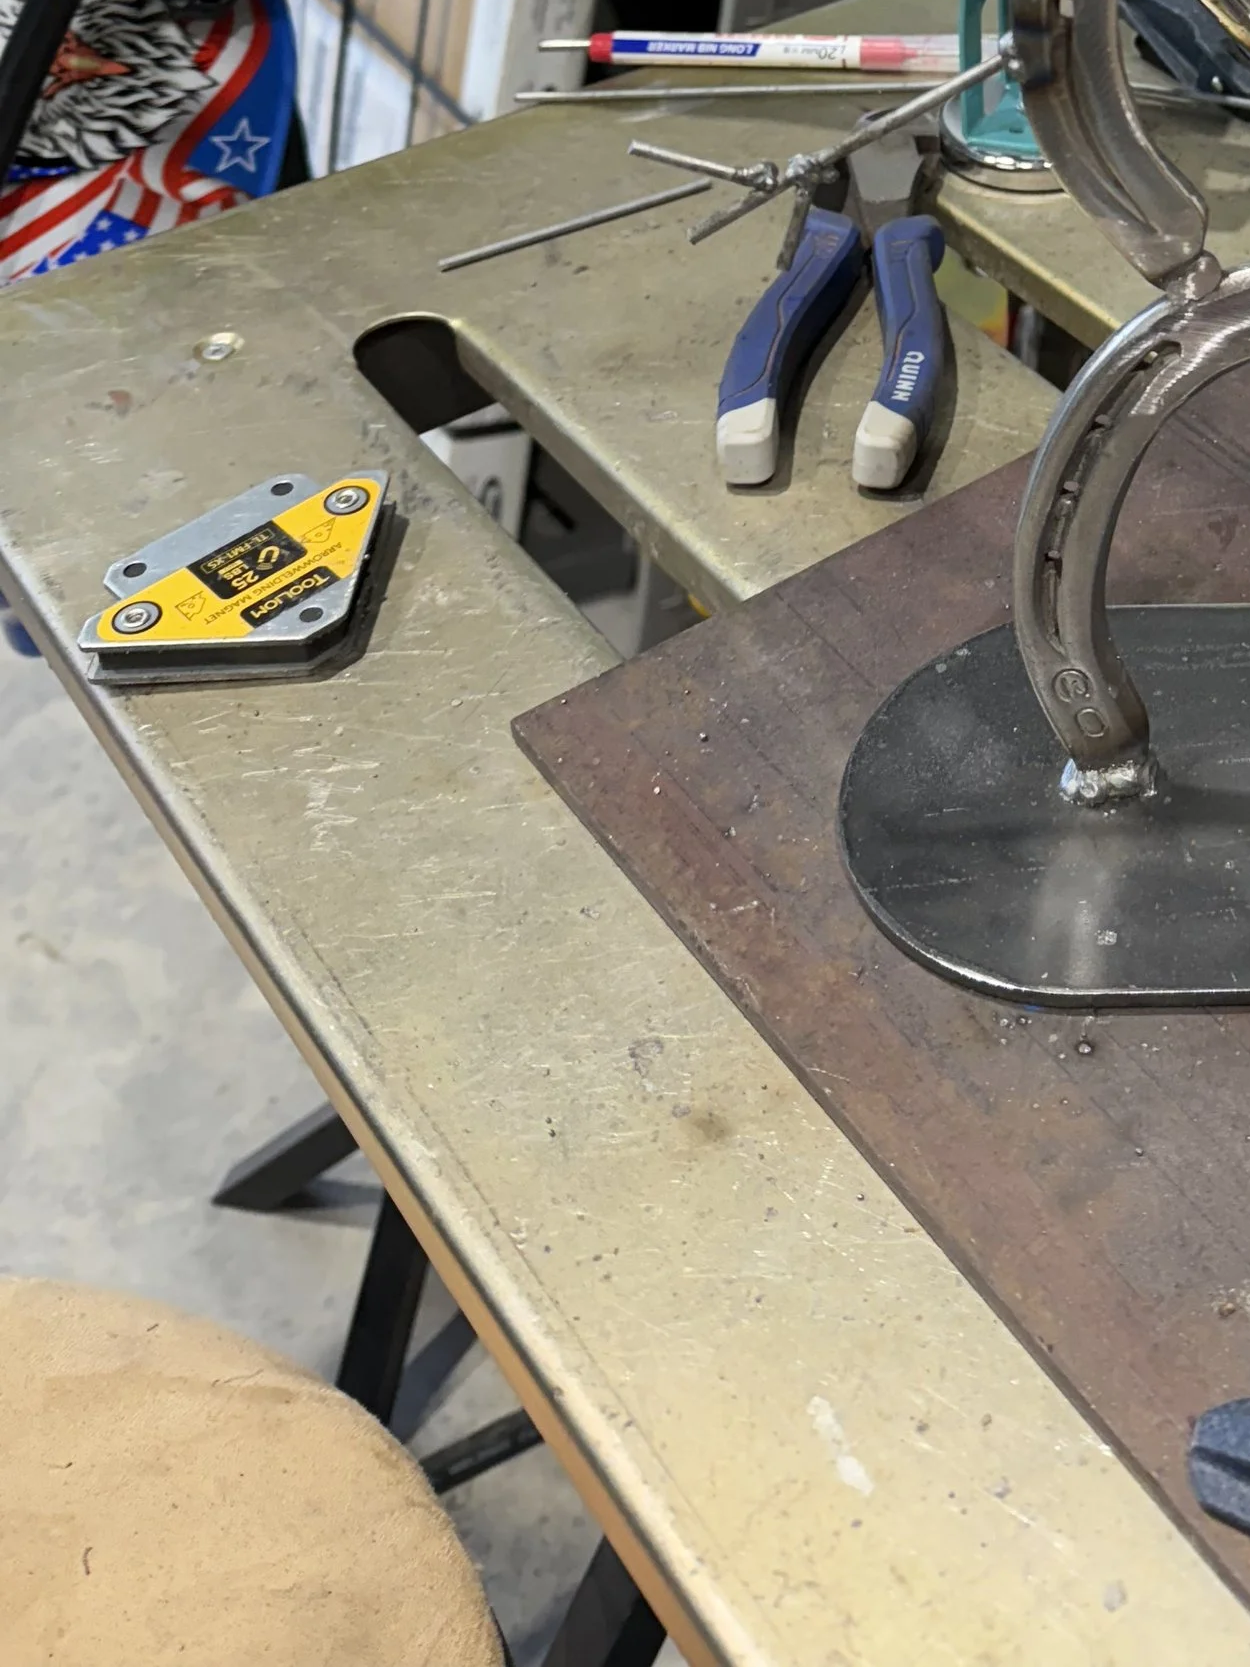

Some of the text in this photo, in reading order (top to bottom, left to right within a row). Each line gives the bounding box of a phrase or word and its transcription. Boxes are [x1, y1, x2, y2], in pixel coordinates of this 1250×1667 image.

[646, 40, 754, 55] LONG NIB MARKER
[891, 350, 926, 402] QUINN
[223, 562, 249, 581] LBS
[231, 570, 260, 591] 25
[204, 594, 251, 625] MAGNET
